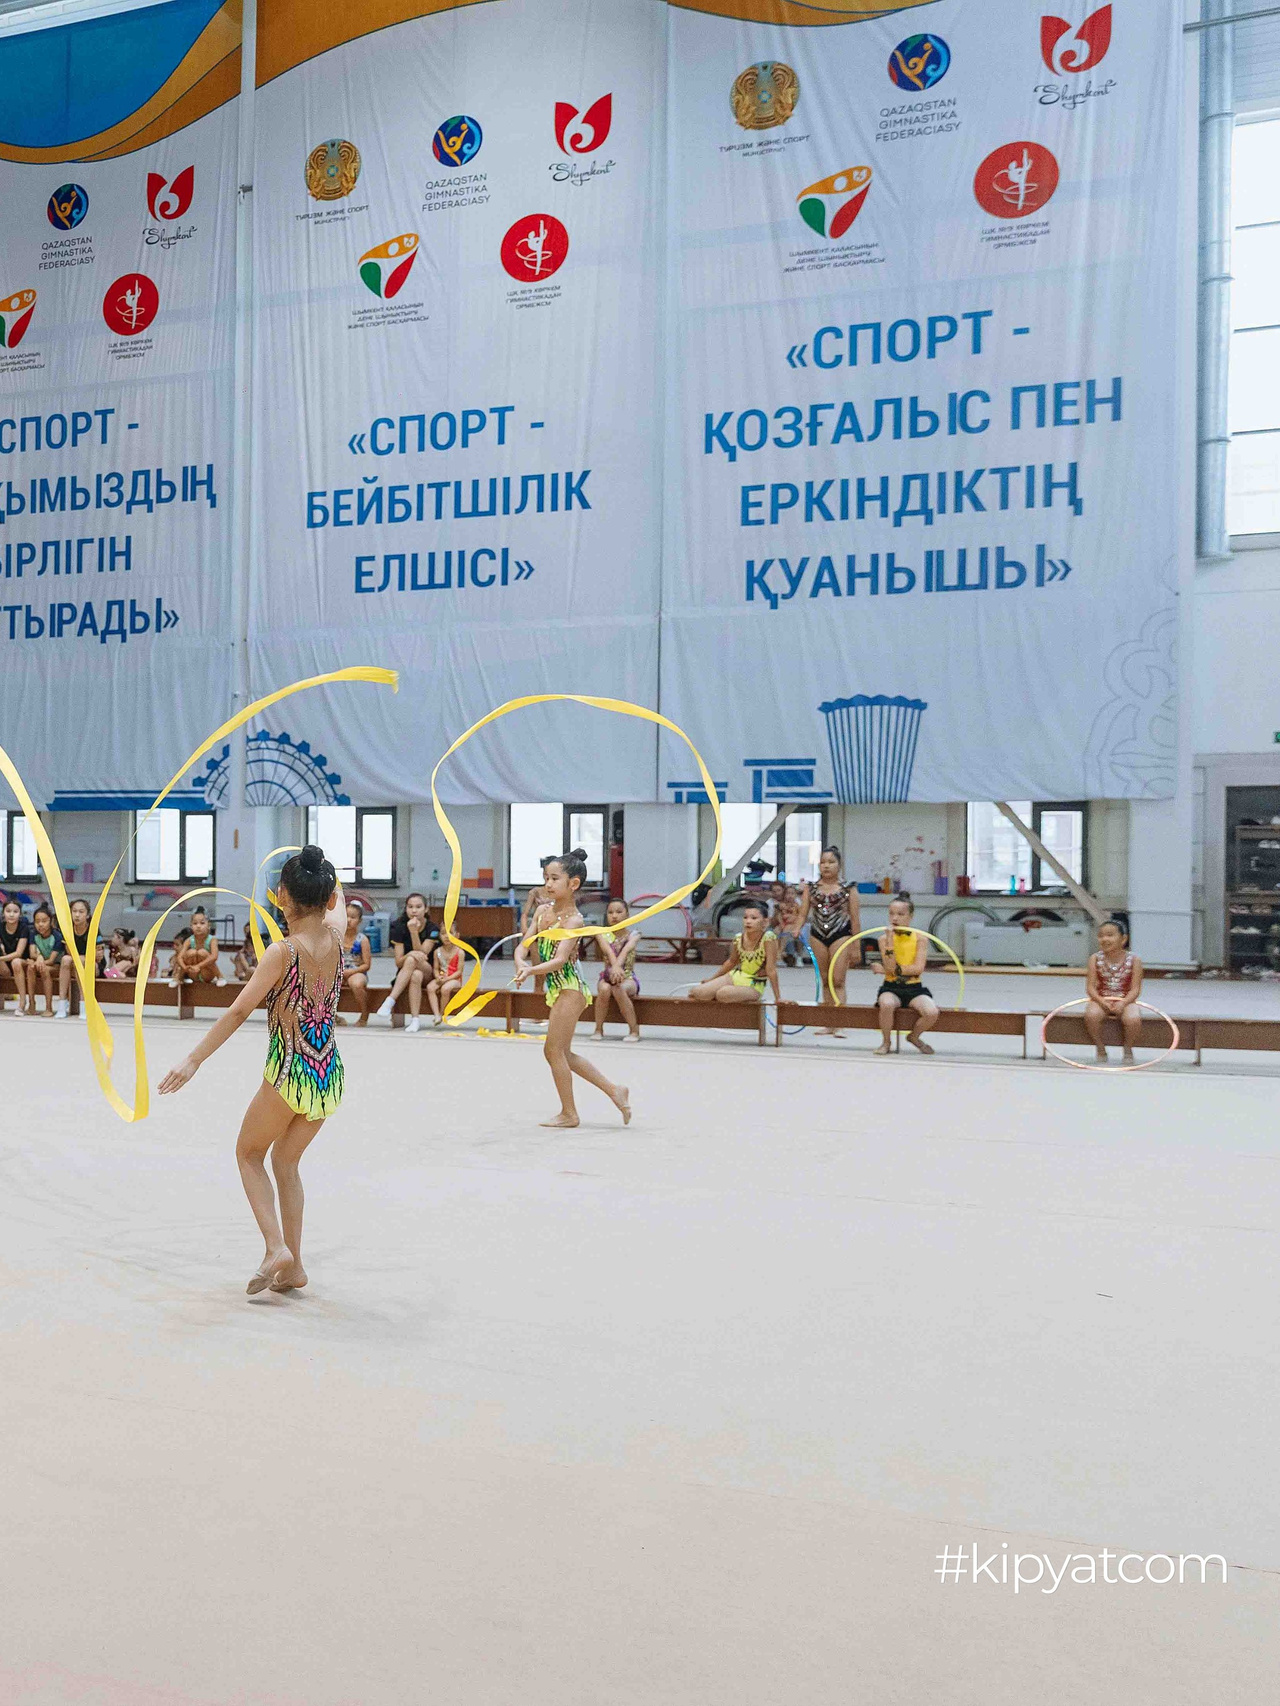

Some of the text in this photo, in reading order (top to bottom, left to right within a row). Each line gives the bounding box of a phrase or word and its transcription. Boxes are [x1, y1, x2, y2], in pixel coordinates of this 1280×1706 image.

[879, 97, 957, 118] QAZAQSTAN
[878, 109, 958, 130] GIMNASTIKA
[874, 121, 962, 143] FEDERACIASY
[425, 173, 488, 190] QAZAQSTAN
[424, 184, 488, 202] GIMNASTIKA
[421, 195, 491, 213] FEDERACIASY
[40, 246, 93, 261] GIMNASTIKA
[41, 236, 93, 250] QAZAQSTAN
[38, 256, 96, 271] FEDERACIASY
[786, 310, 1030, 370] «СПОРТ -
[703, 376, 1123, 463] ҚОЗҒАЛЫС ПЕН
[347, 405, 544, 456] «СПОРТ -
[306, 469, 592, 529] БЕЙБІТШІЛІК
[740, 461, 1083, 527] ЕРКІНДІКТІҢ
[354, 547, 535, 594] ЕЛШІСІ»
[745, 544, 1072, 610] ҚУАНЫШЫ»
